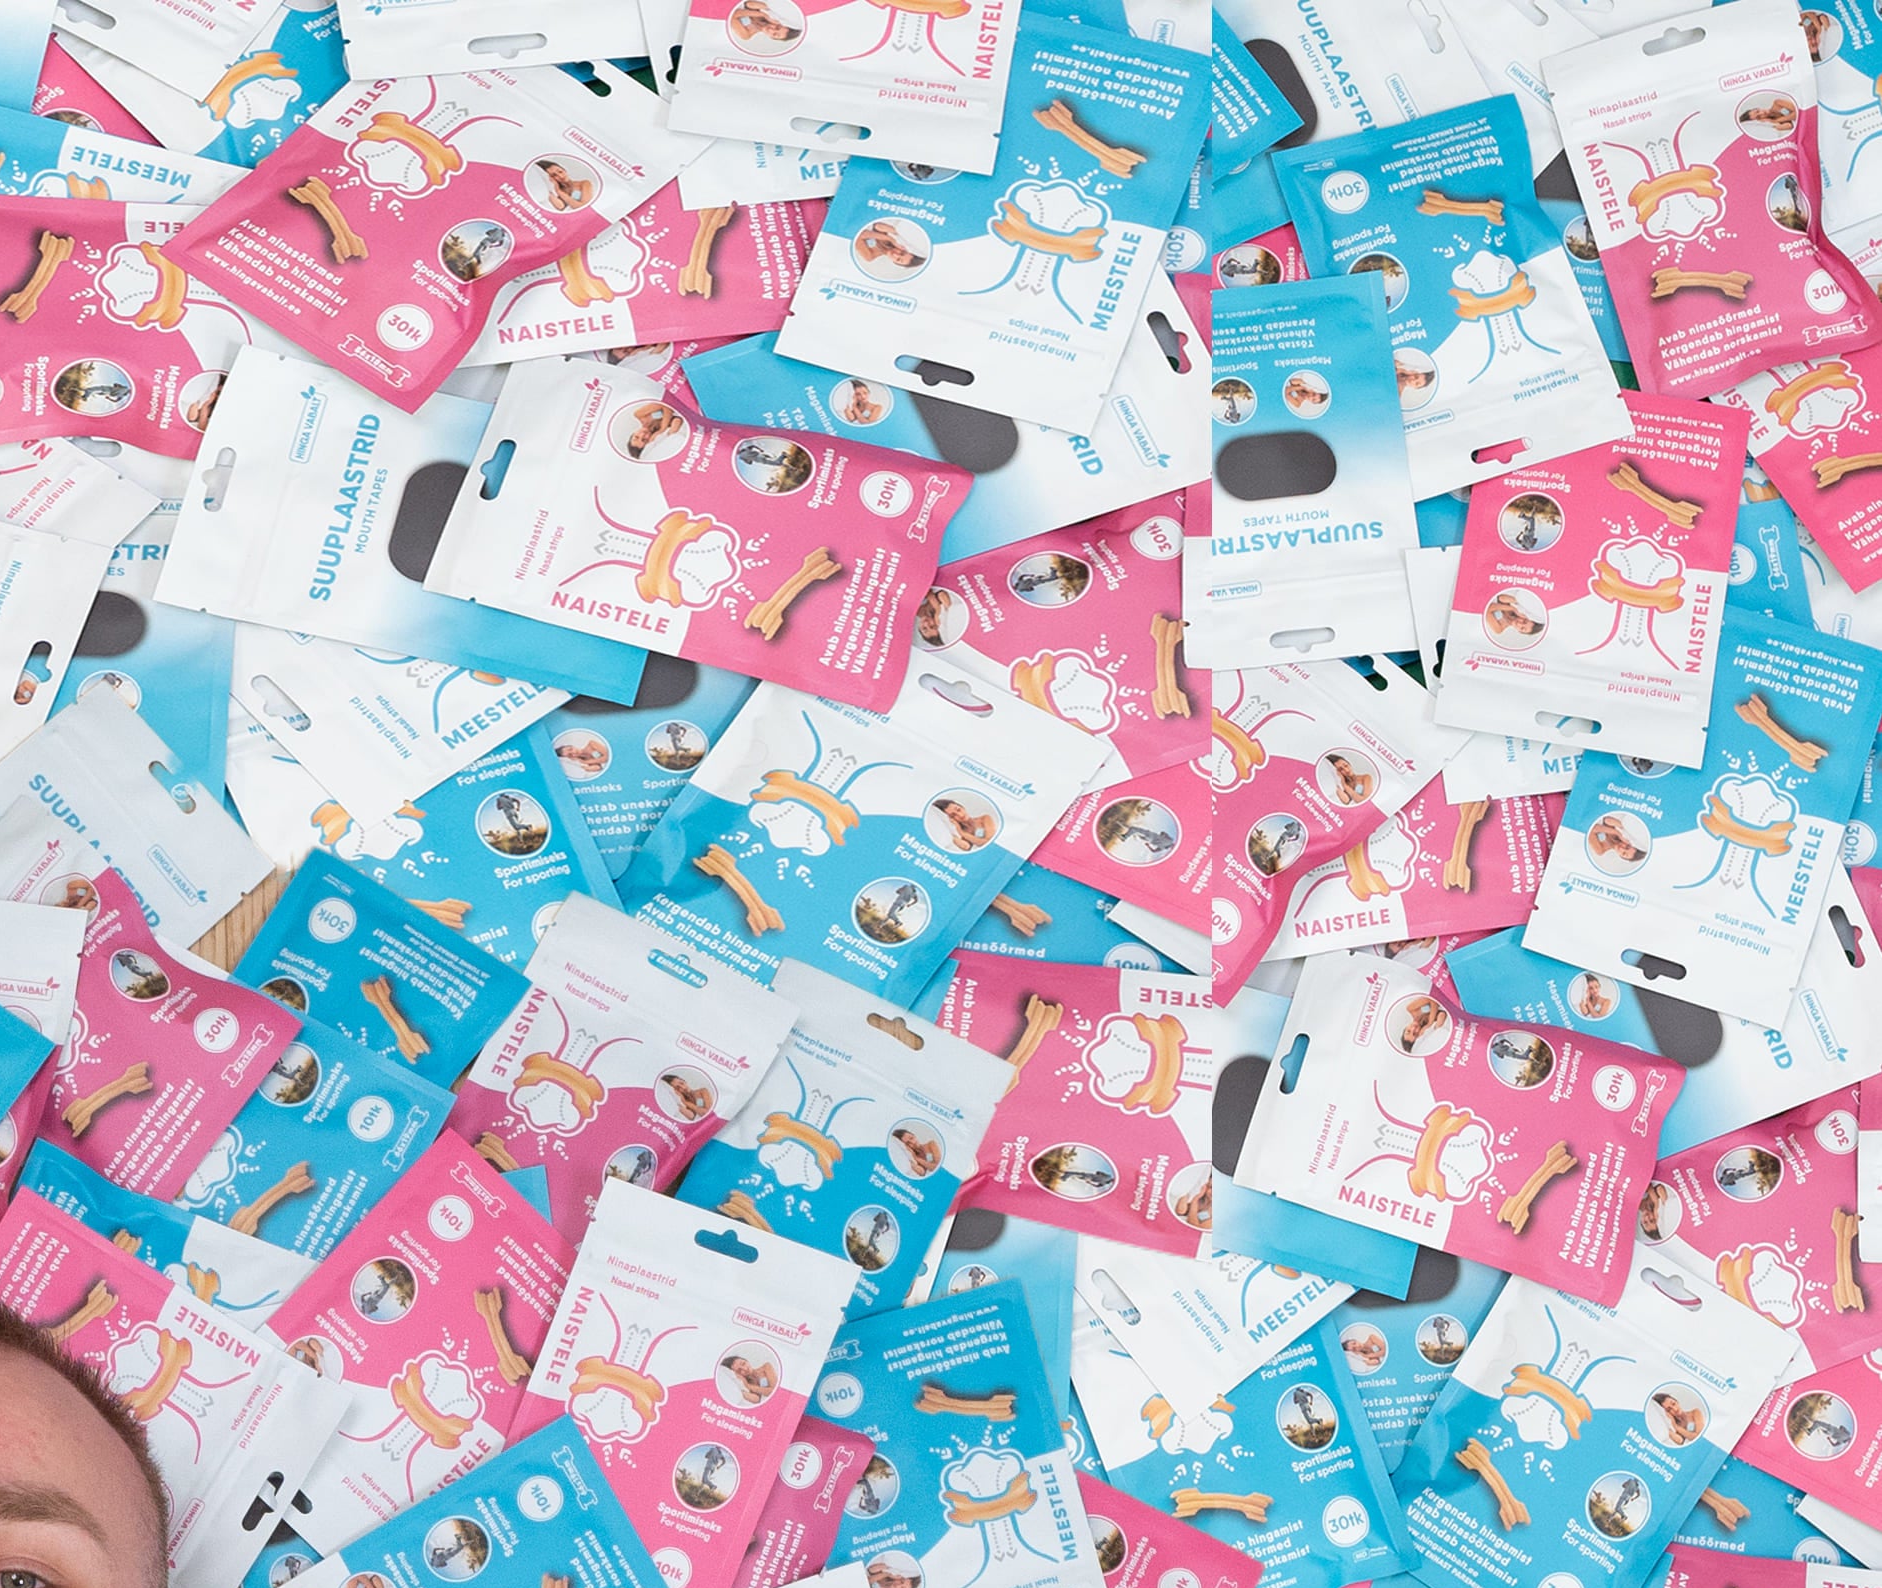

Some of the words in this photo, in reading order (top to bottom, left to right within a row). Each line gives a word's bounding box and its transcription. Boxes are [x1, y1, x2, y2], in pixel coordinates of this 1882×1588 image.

[1719, 73, 1753, 89] HINGA
[1752, 63, 1785, 79] VABALT
[1588, 90, 1658, 118] Ninaplaastrid
[1329, 181, 1365, 200] 30tk
[1583, 143, 1626, 232] NAISTELE
[1089, 231, 1142, 332] MEESTELE
[497, 314, 615, 345] NAISTELE
[308, 414, 381, 601] SUUPLAASTRID
[354, 508, 377, 554] MOUTH
[366, 468, 389, 506] TAPES
[1294, 908, 1391, 939] NAISTELE
[204, 1014, 230, 1043] 30tk
[491, 987, 548, 1078] NAISTELE
[1606, 1072, 1624, 1103] 30tk
[359, 1104, 383, 1131] 10tk
[1338, 1184, 1437, 1229] NAISTELE
[174, 1305, 261, 1368] NAISTELE
